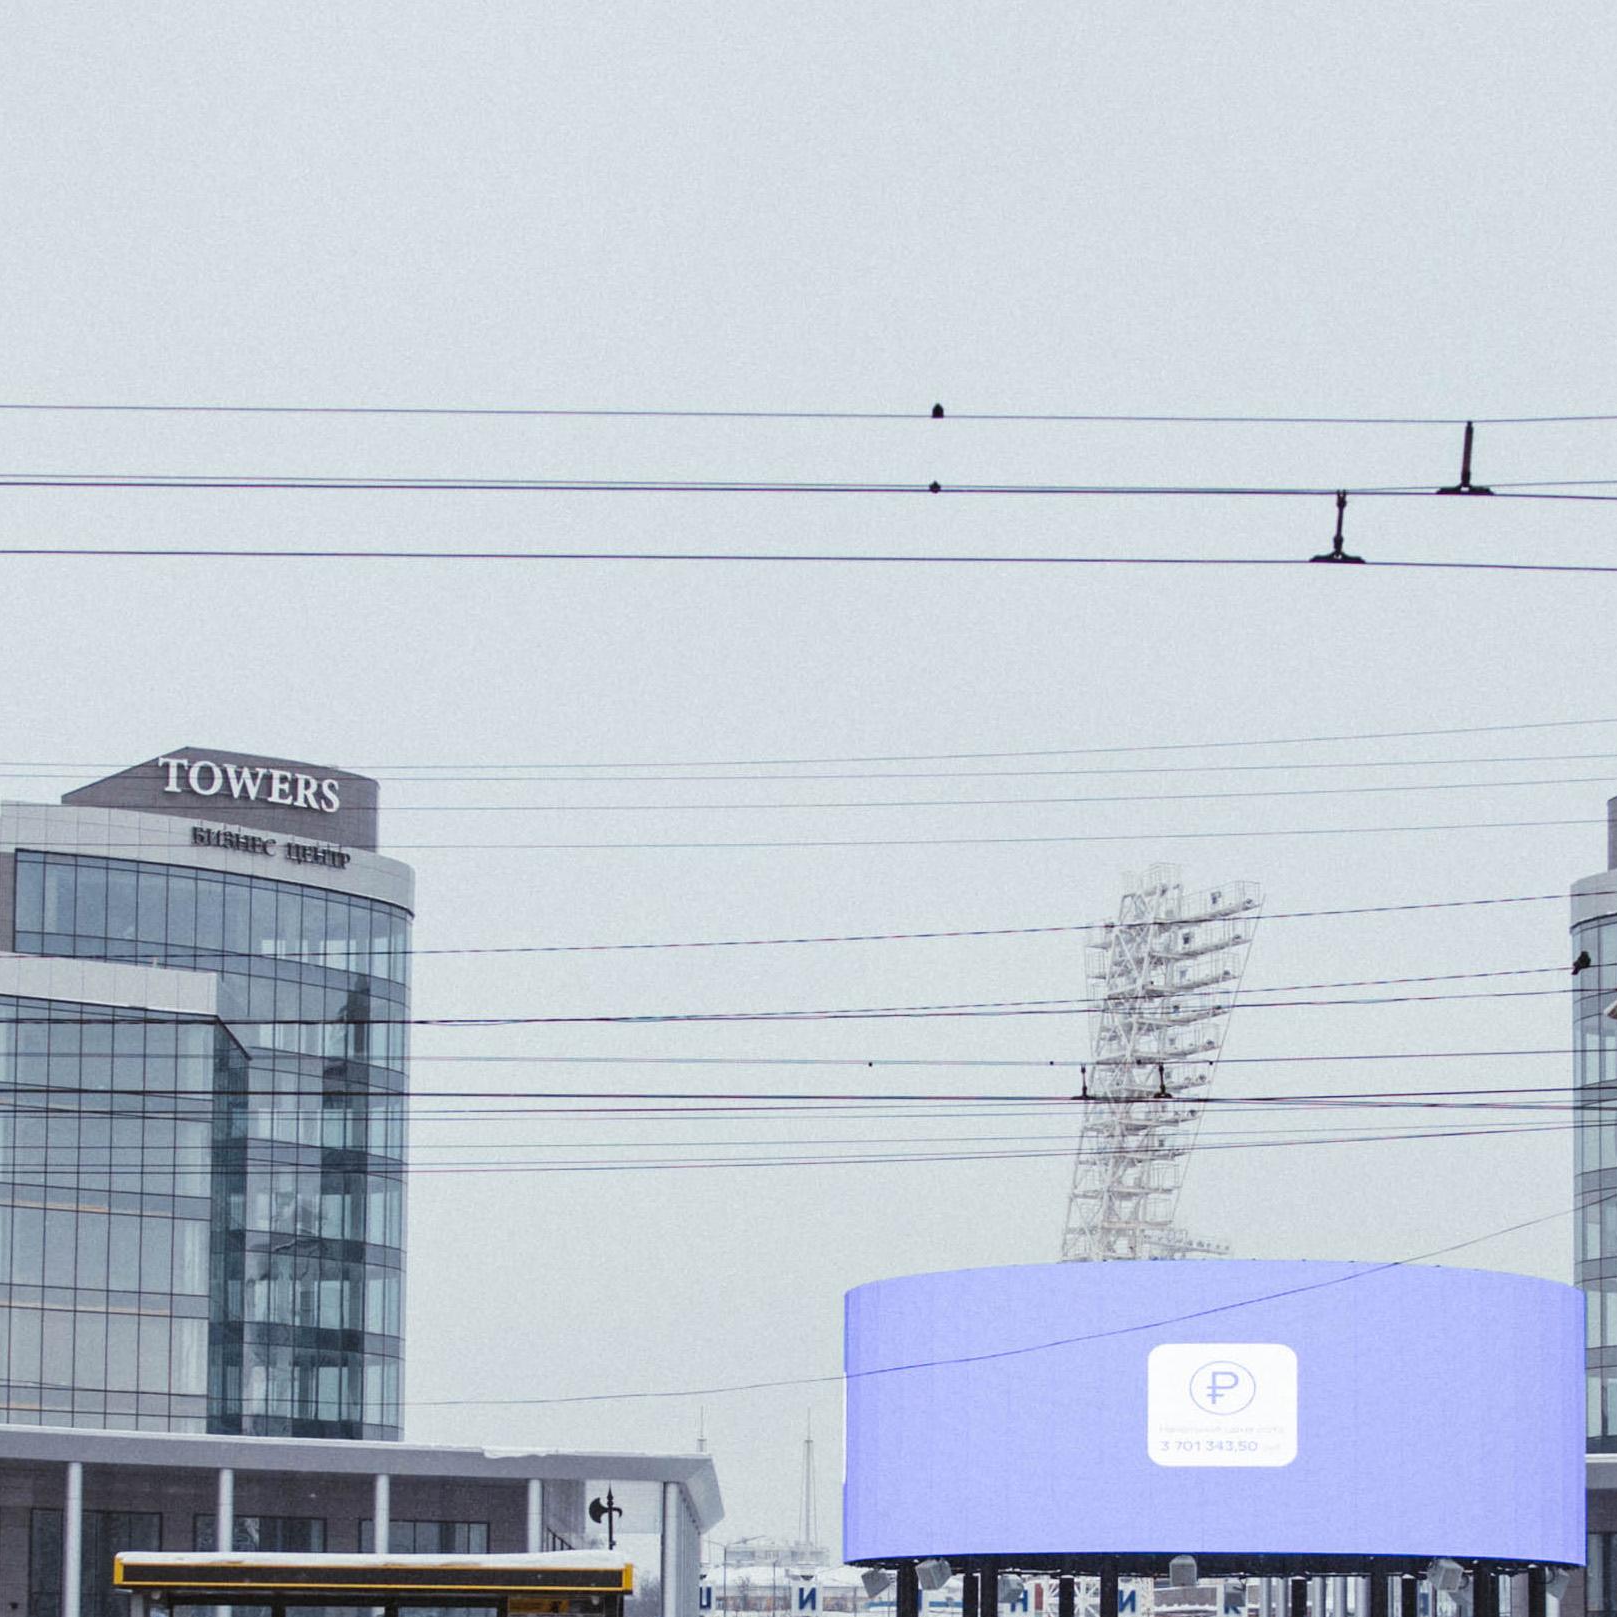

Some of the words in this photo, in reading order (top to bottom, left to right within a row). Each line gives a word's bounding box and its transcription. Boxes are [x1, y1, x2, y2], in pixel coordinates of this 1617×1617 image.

[158, 757, 341, 813] TOWERS
[191, 826, 277, 857] БИЗНЕС
[285, 841, 352, 870] ЦЕНТР
[1160, 1440, 1170, 1452] 3
[1174, 1440, 1201, 1452] 701
